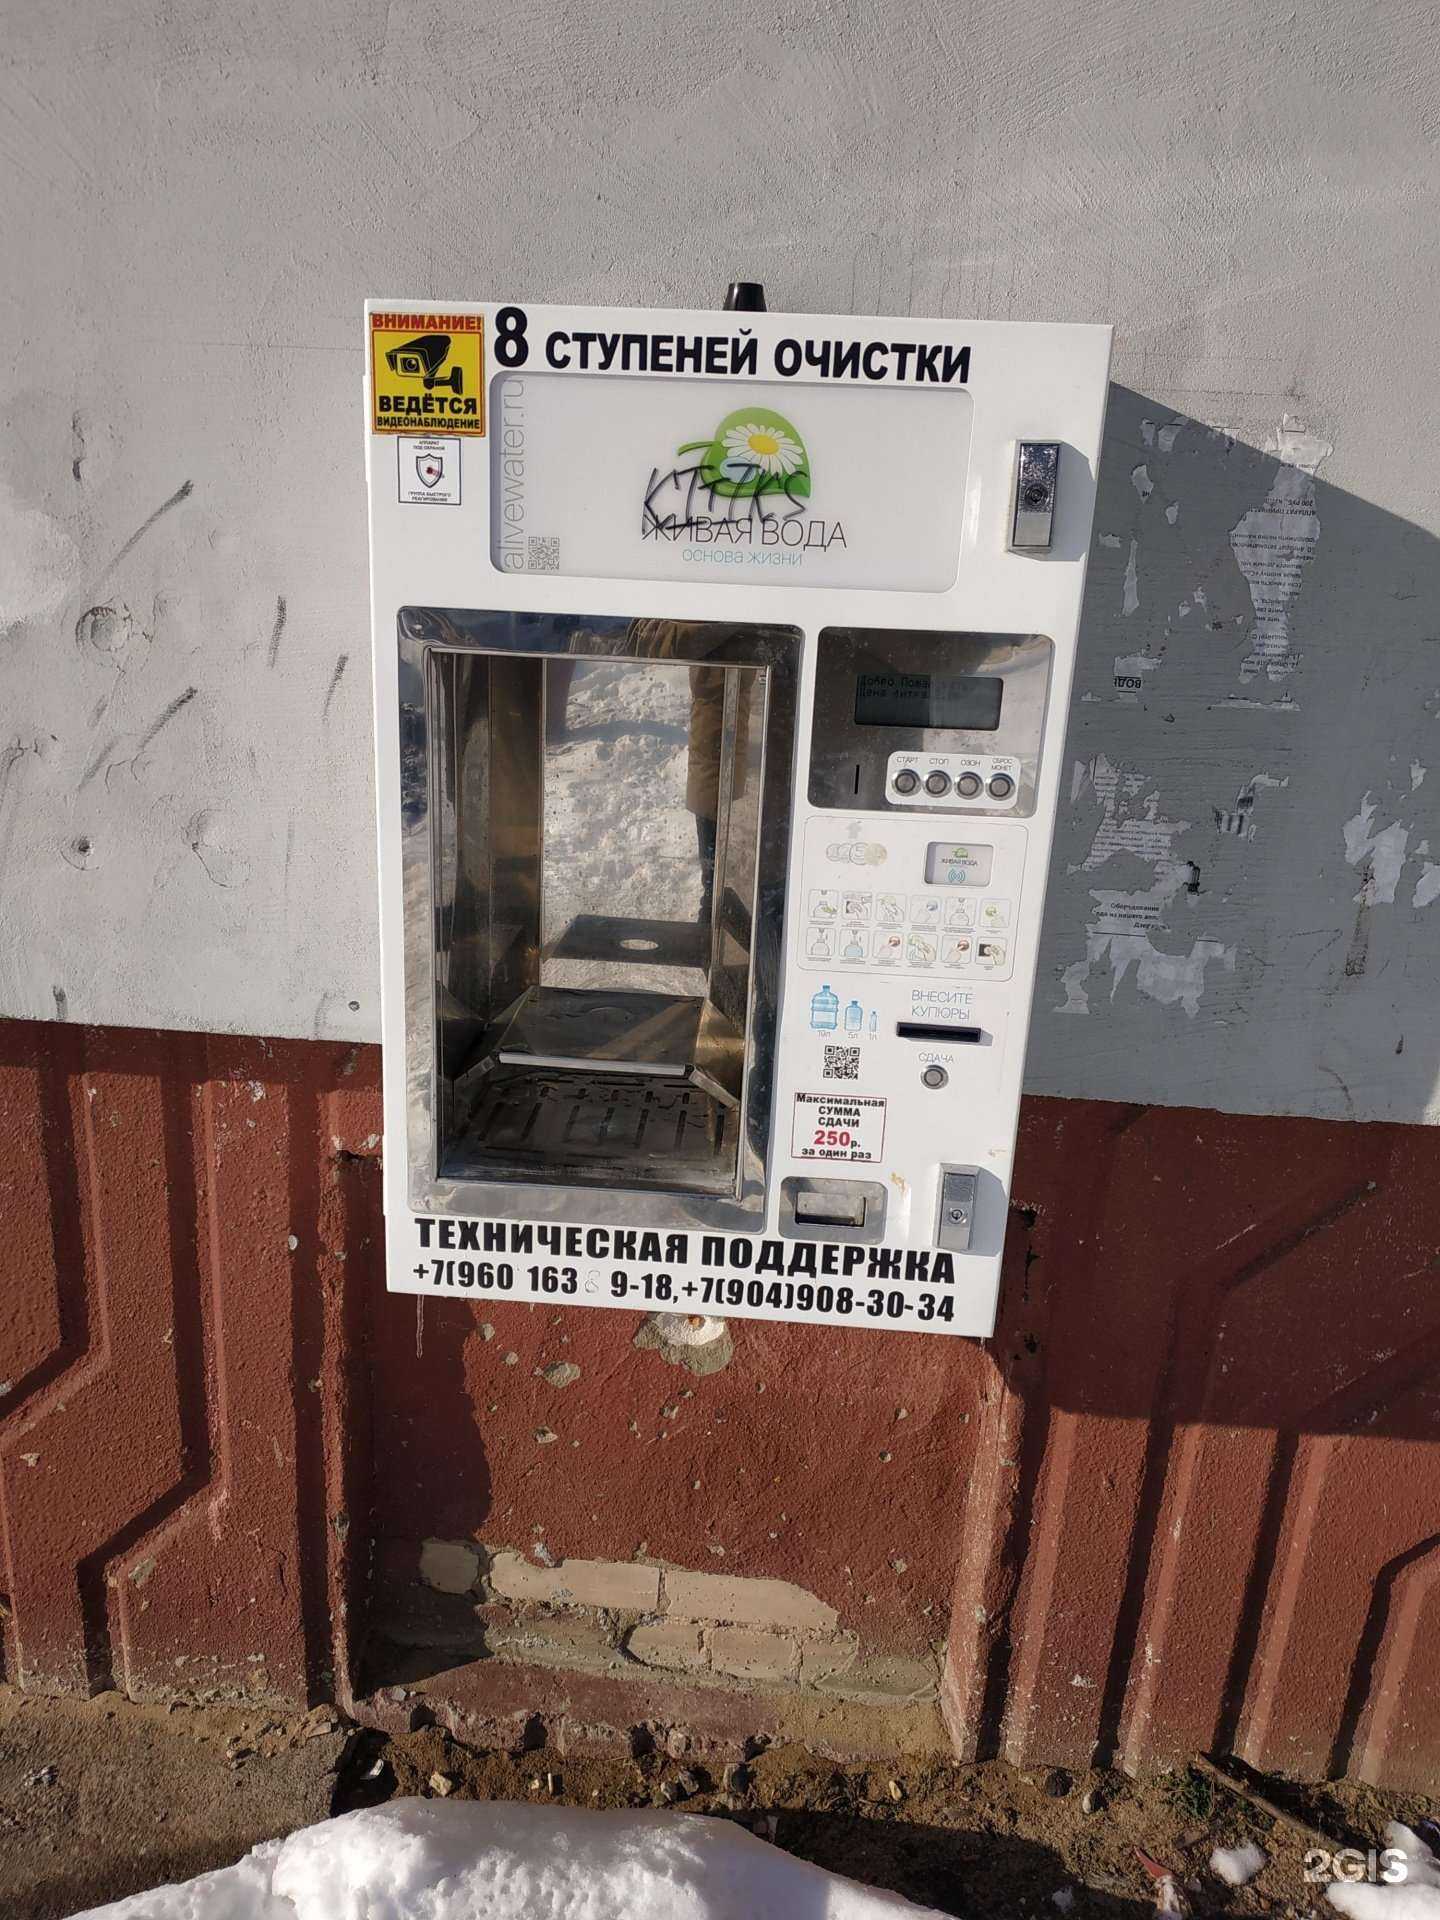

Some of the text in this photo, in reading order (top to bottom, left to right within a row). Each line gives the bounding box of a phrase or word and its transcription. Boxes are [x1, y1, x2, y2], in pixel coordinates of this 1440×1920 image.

[372, 313, 482, 330] ВНИМАНИЕ!
[493, 306, 972, 384] 8 СТУПЕНЕЙ ОЧИСТКИ
[379, 393, 478, 416] ВЕДЁТСЯ
[377, 416, 481, 430] ВИДЕОНАБЛЮДЕНИЕ
[497, 379, 525, 570] alivewater.ru
[641, 514, 848, 552] ЖИВАЯ ВОДА
[682, 549, 803, 567] основа жизни
[911, 989, 974, 1005] ВНЕСИТЕ
[911, 1005, 971, 1020] КУПЮРЫ
[918, 1051, 955, 1064] СДАЧА
[796, 1093, 885, 1107] Максимальная
[818, 1106, 861, 1117] СУММА
[818, 1117, 860, 1128] СДАЧИ
[801, 1148, 872, 1160] за один раз
[414, 1217, 956, 1285] ТЕХНИЧЕСКАЯ ПОДДЕРЖКА
[413, 1258, 514, 1291] +7(960
[526, 1265, 578, 1295] 163
